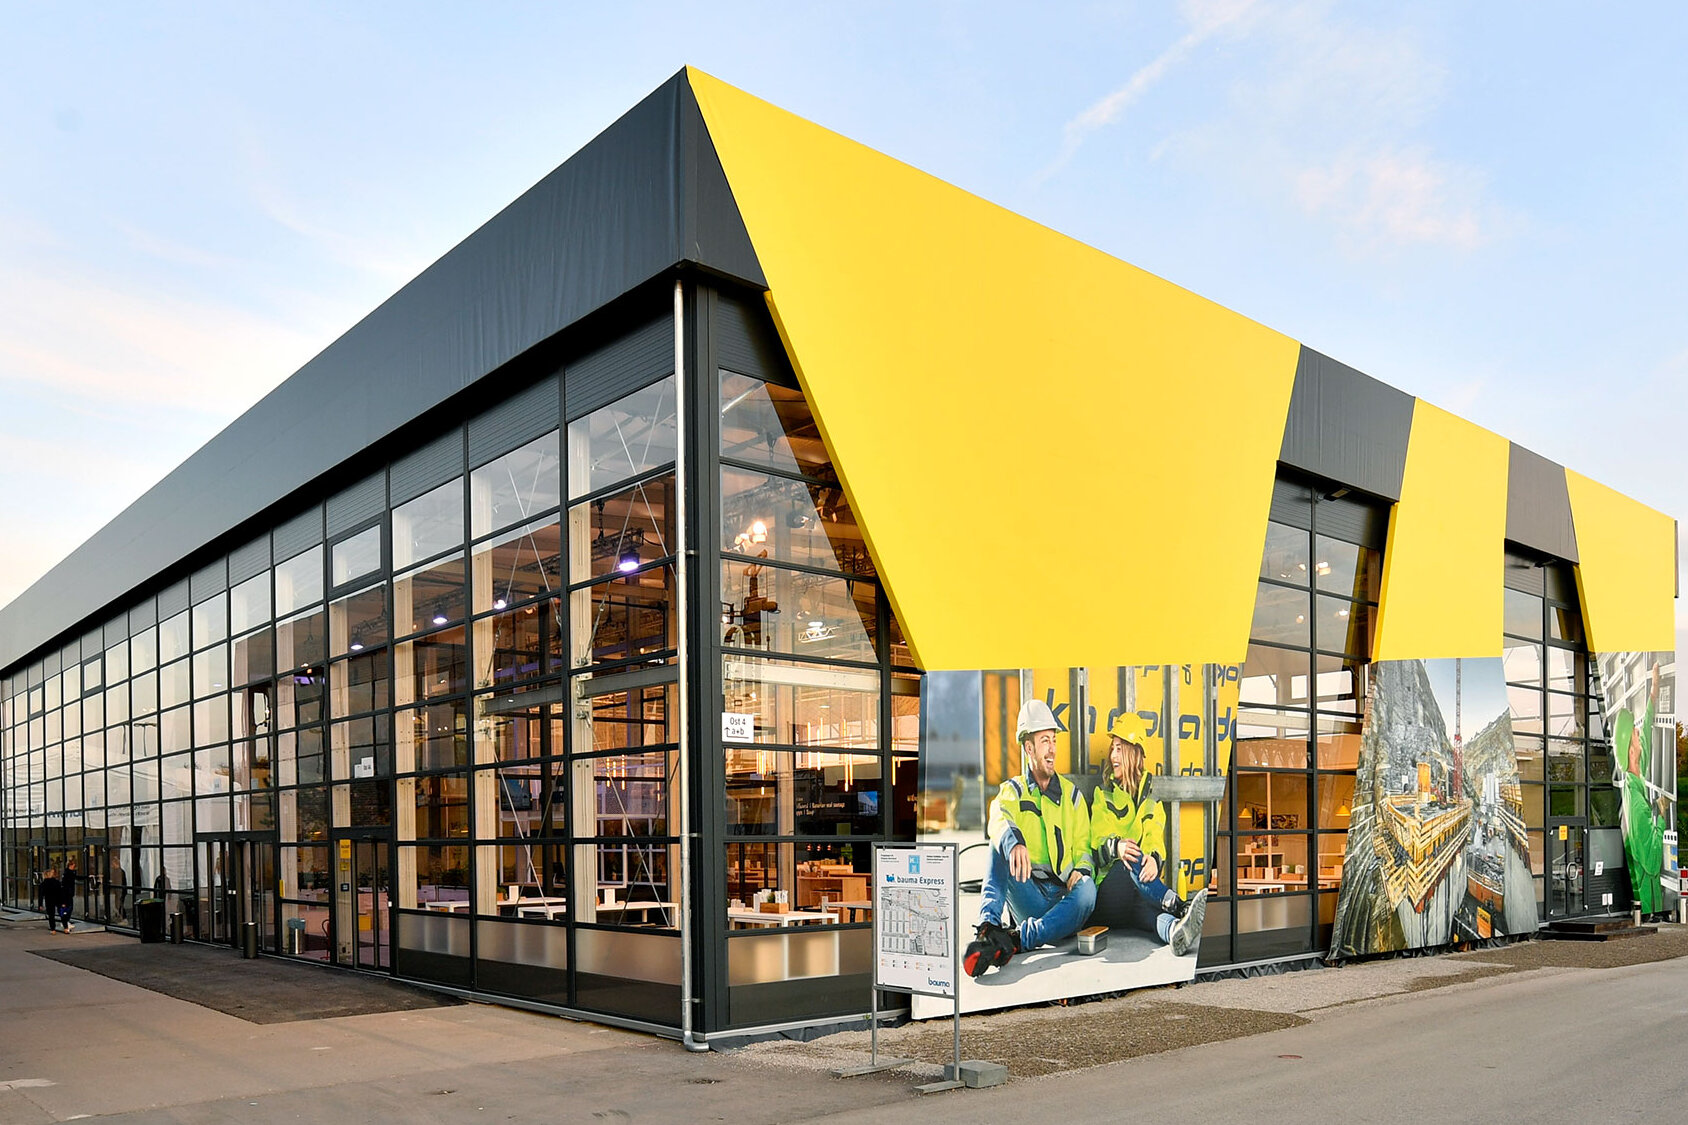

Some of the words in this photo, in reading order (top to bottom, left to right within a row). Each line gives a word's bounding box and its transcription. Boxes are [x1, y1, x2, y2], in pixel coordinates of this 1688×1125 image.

[729, 716, 741, 726] Ost
[742, 718, 746, 726] 4
[896, 876, 918, 884] bauma
[919, 876, 945, 885] Express
[928, 976, 951, 988] bauma
